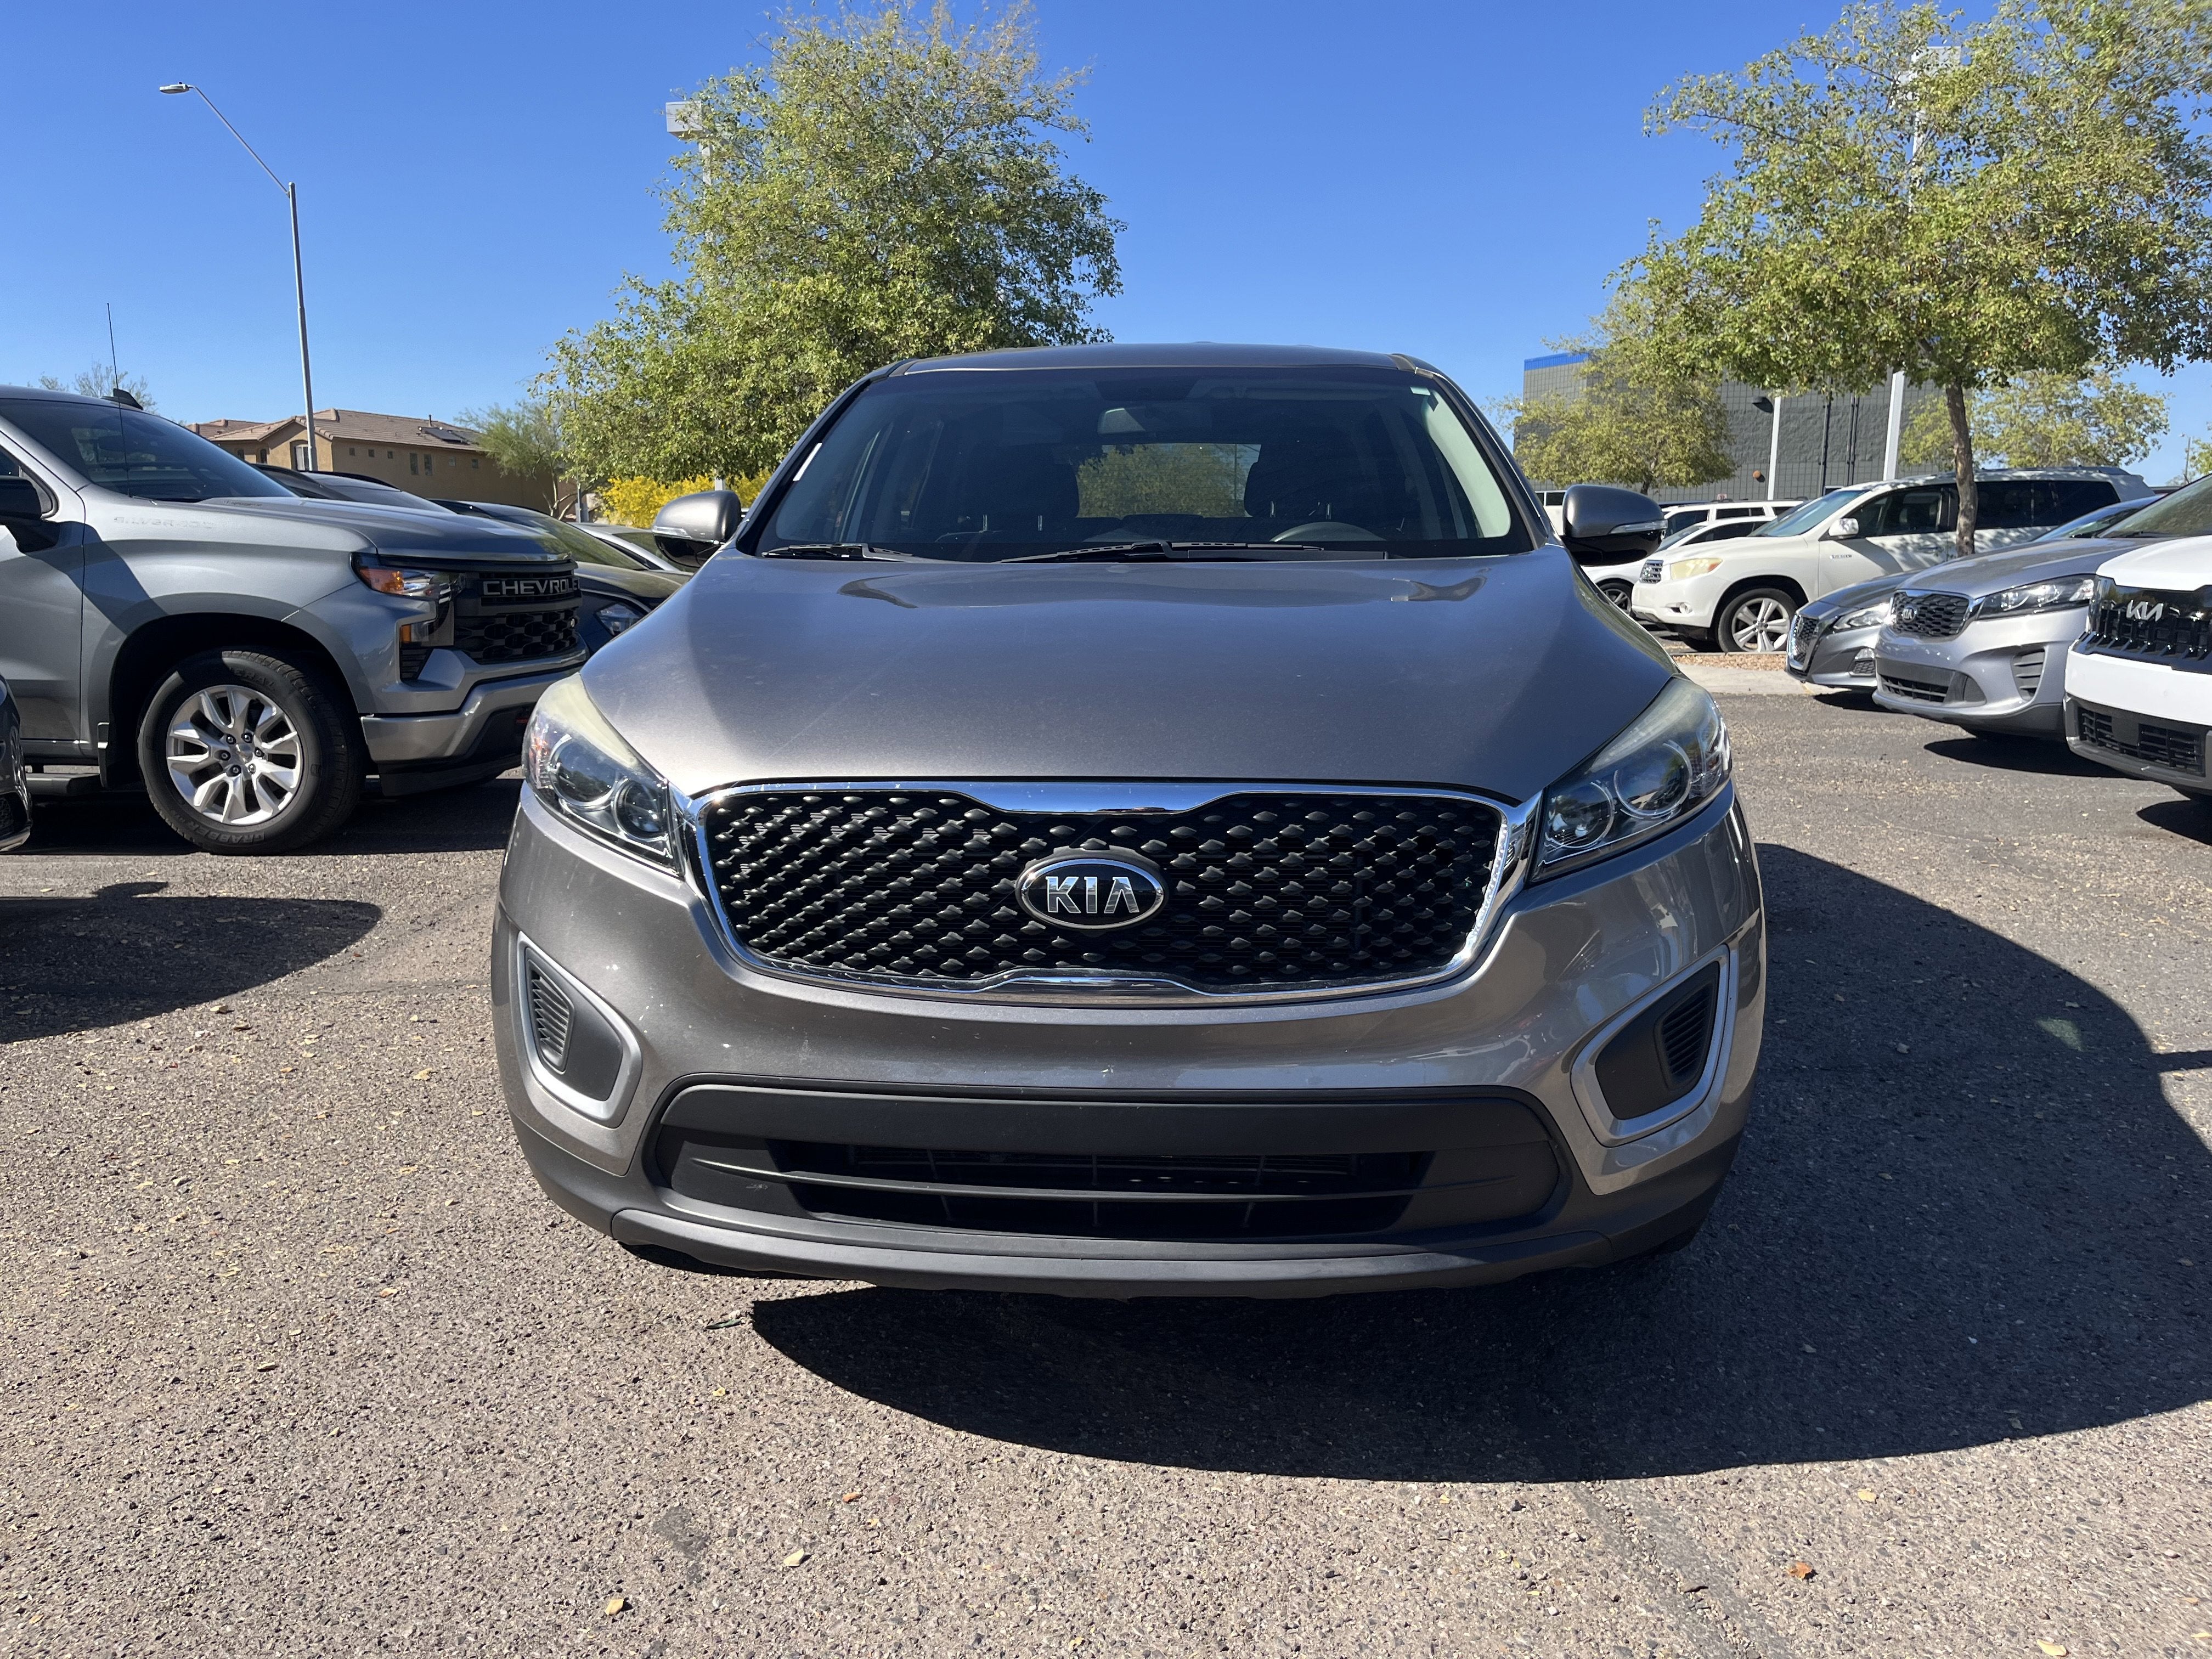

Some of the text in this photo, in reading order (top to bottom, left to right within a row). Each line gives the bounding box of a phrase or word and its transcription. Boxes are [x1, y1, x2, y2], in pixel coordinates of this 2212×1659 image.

[483, 579, 580, 595] CHEVROLE
[2126, 600, 2164, 622] KIA
[1045, 876, 1140, 913] KIA
